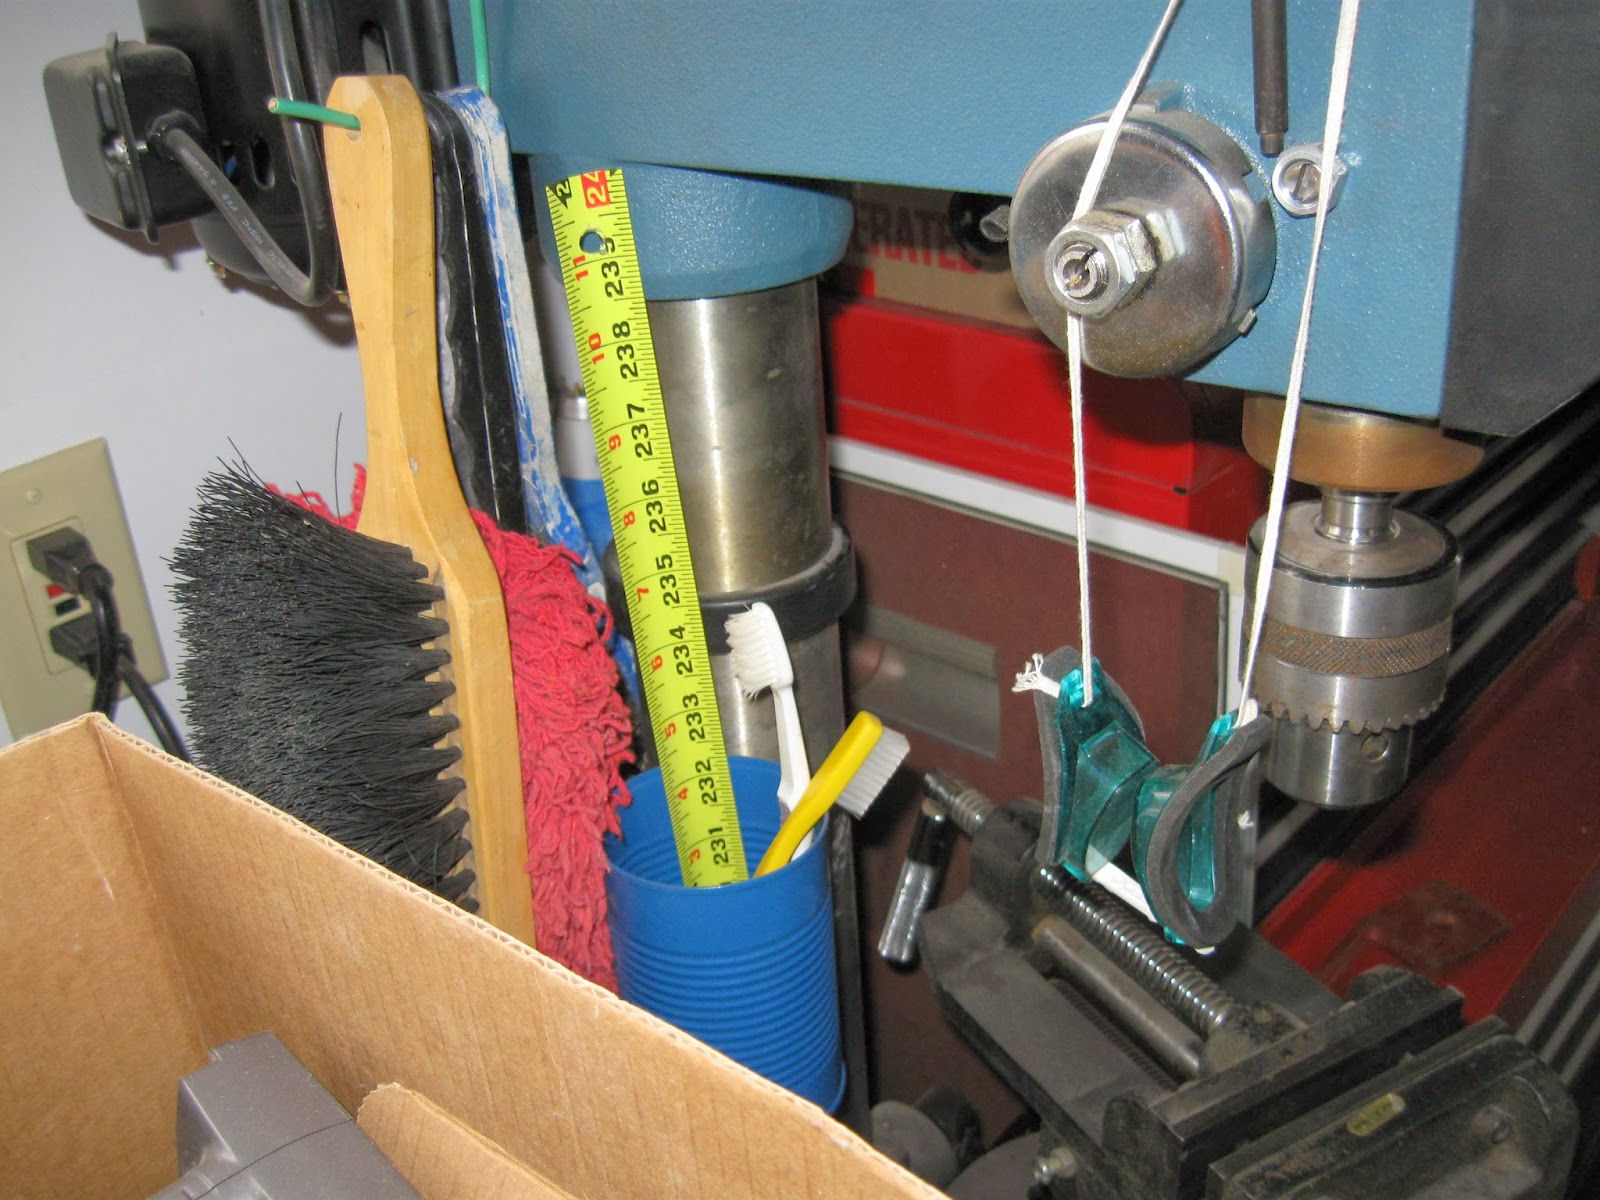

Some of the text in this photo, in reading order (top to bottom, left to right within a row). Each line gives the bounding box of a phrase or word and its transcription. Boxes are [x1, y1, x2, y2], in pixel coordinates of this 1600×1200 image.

[572, 255, 589, 281] 11
[588, 332, 605, 365] 10
[612, 321, 639, 380] 238
[608, 434, 622, 451] 9
[627, 403, 653, 458] 237
[623, 510, 636, 526] 8
[641, 479, 667, 534] 236
[637, 587, 650, 602] 7
[655, 554, 681, 606] 235
[651, 655, 663, 671] 6
[669, 625, 694, 676] 234
[664, 722, 677, 738] 5
[682, 693, 706, 742] 233
[678, 787, 688, 800] 4
[695, 758, 718, 805] 232
[689, 849, 700, 864] 3
[708, 827, 729, 866] 231
